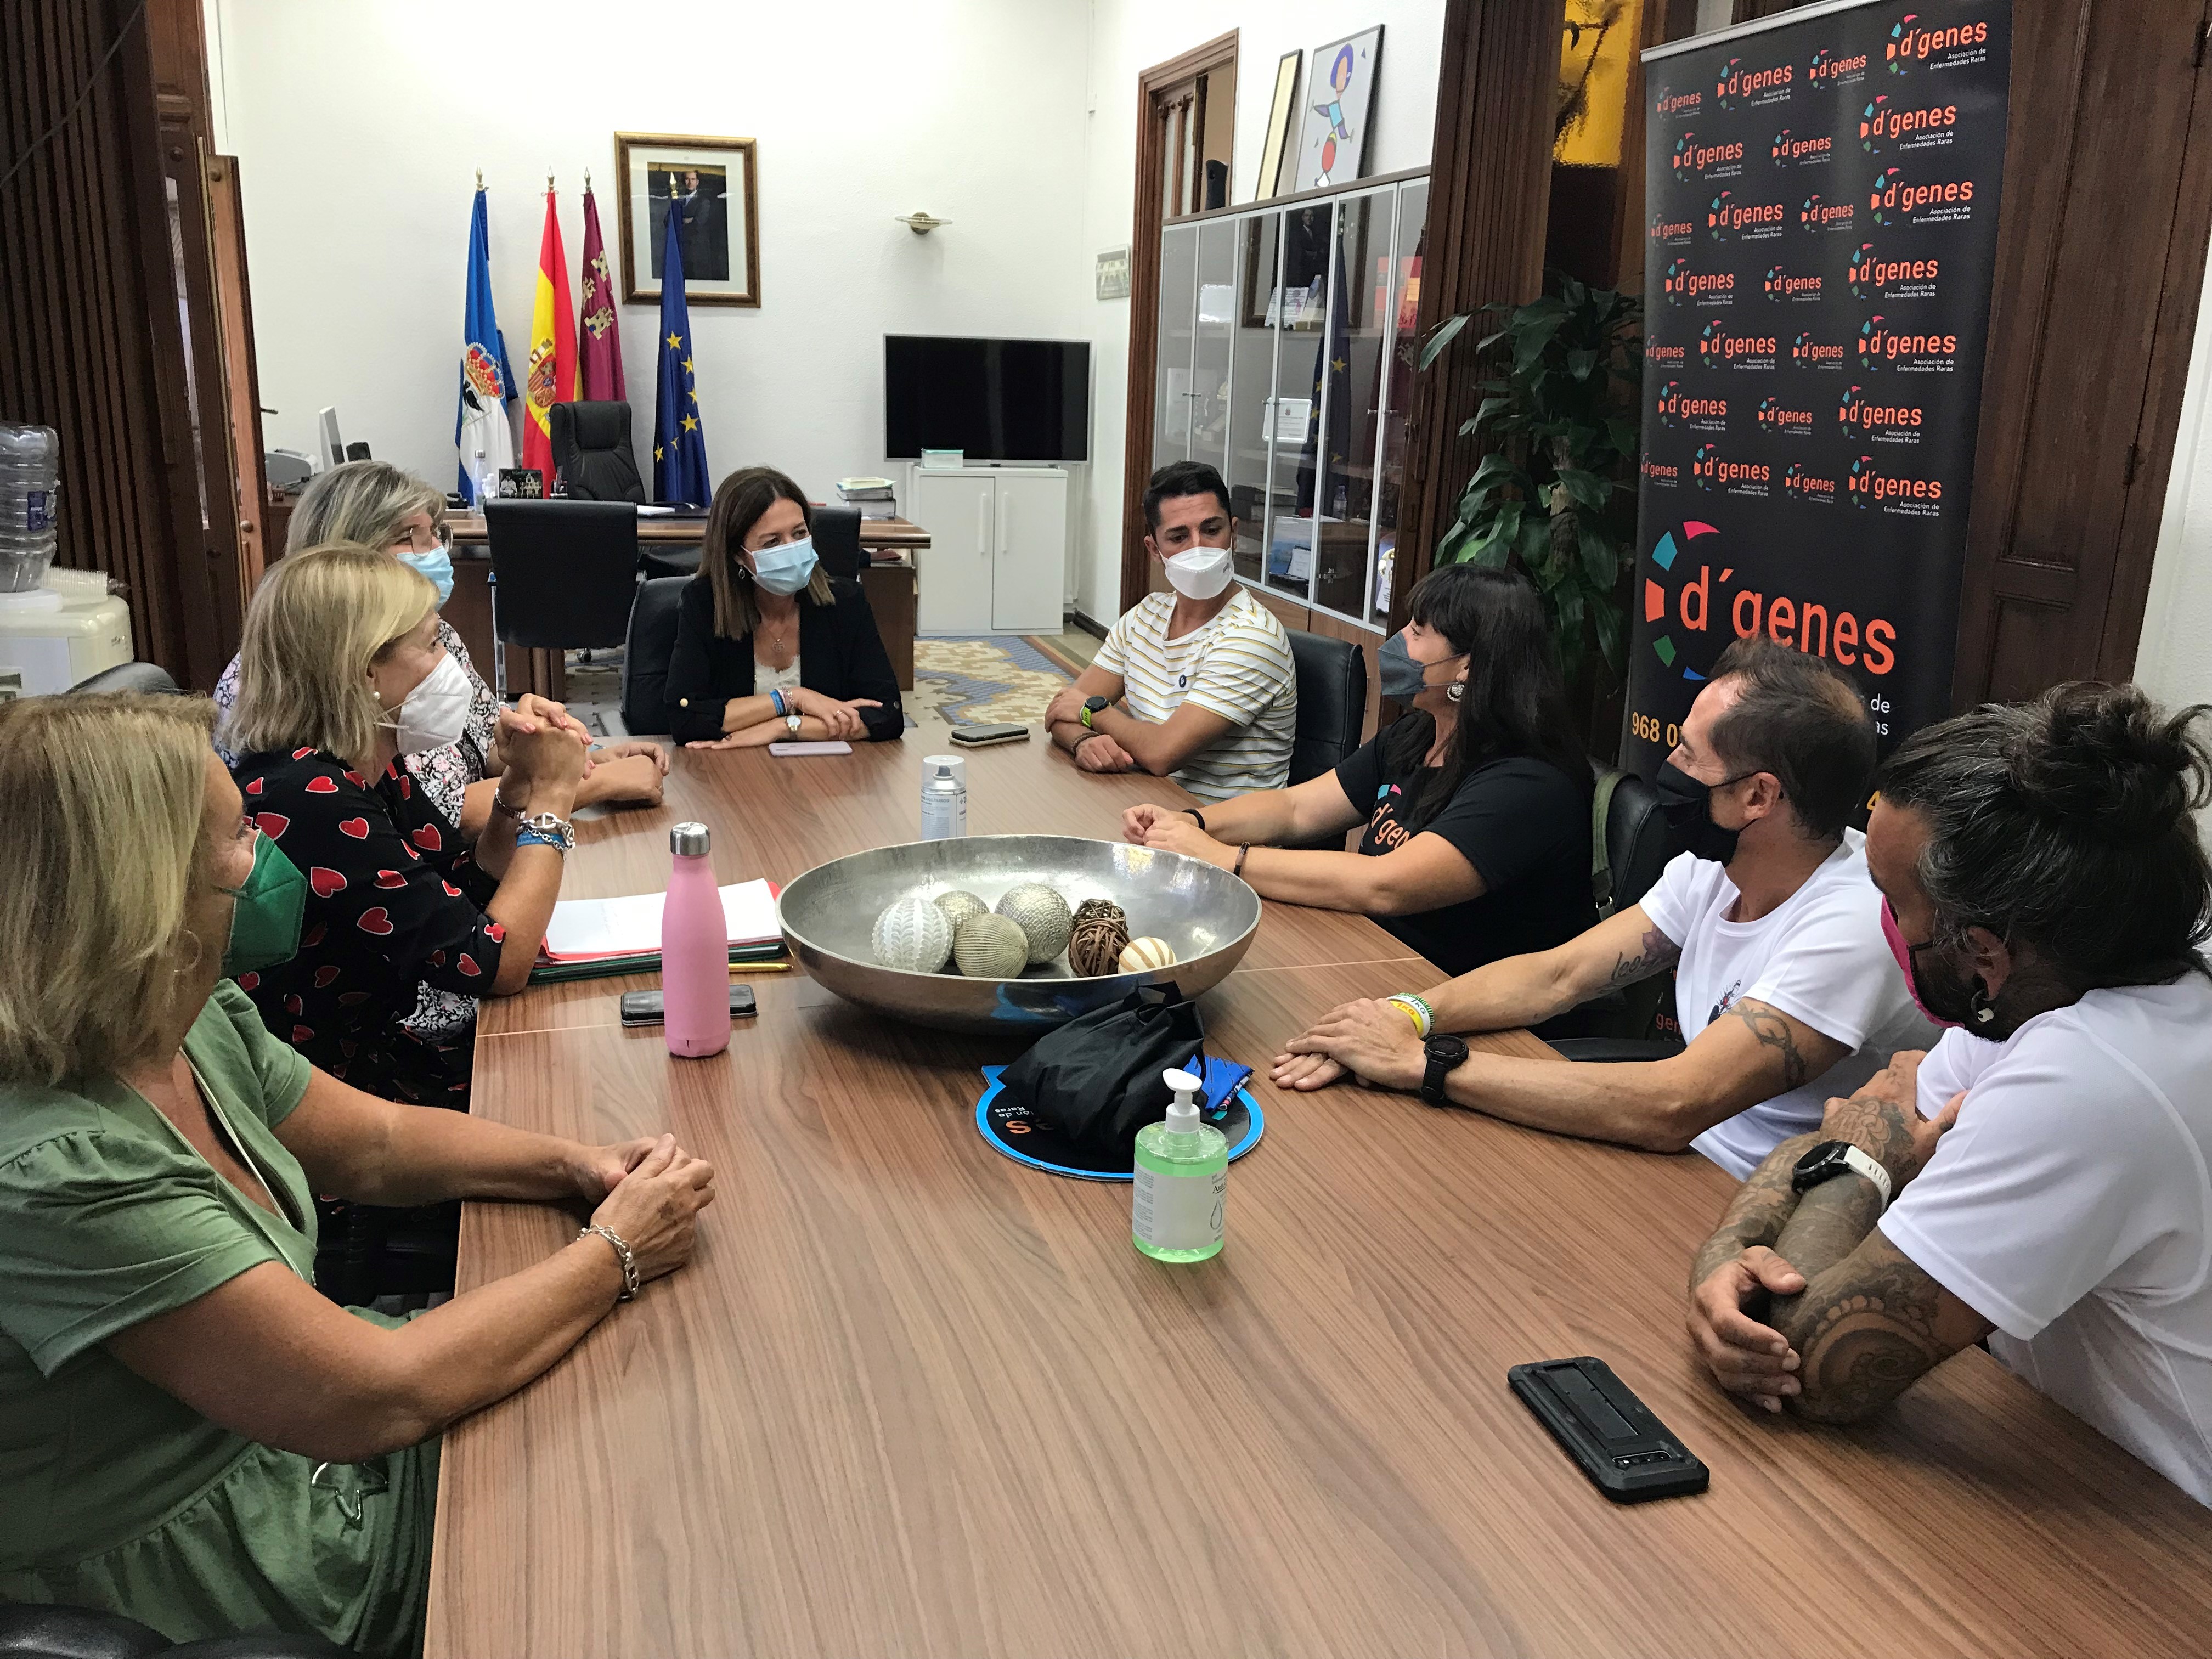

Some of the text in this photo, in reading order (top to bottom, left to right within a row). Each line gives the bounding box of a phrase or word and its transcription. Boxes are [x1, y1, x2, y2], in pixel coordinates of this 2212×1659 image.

[1900, 22, 1987, 59] d´genes
[1948, 49, 1977, 59] Asociación
[1930, 59, 1970, 70] Enfermedades
[1873, 105, 1956, 139] d´genes
[1884, 181, 1973, 212] d´genes
[1860, 257, 1938, 286] d´genes
[1871, 329, 1956, 359] d´genes
[1849, 400, 1922, 428] d´genes
[1860, 470, 1941, 499] d´genes
[1871, 694, 1890, 713] de
[1632, 712, 1678, 747] 968 0
[1371, 803, 1410, 849] d´gen
